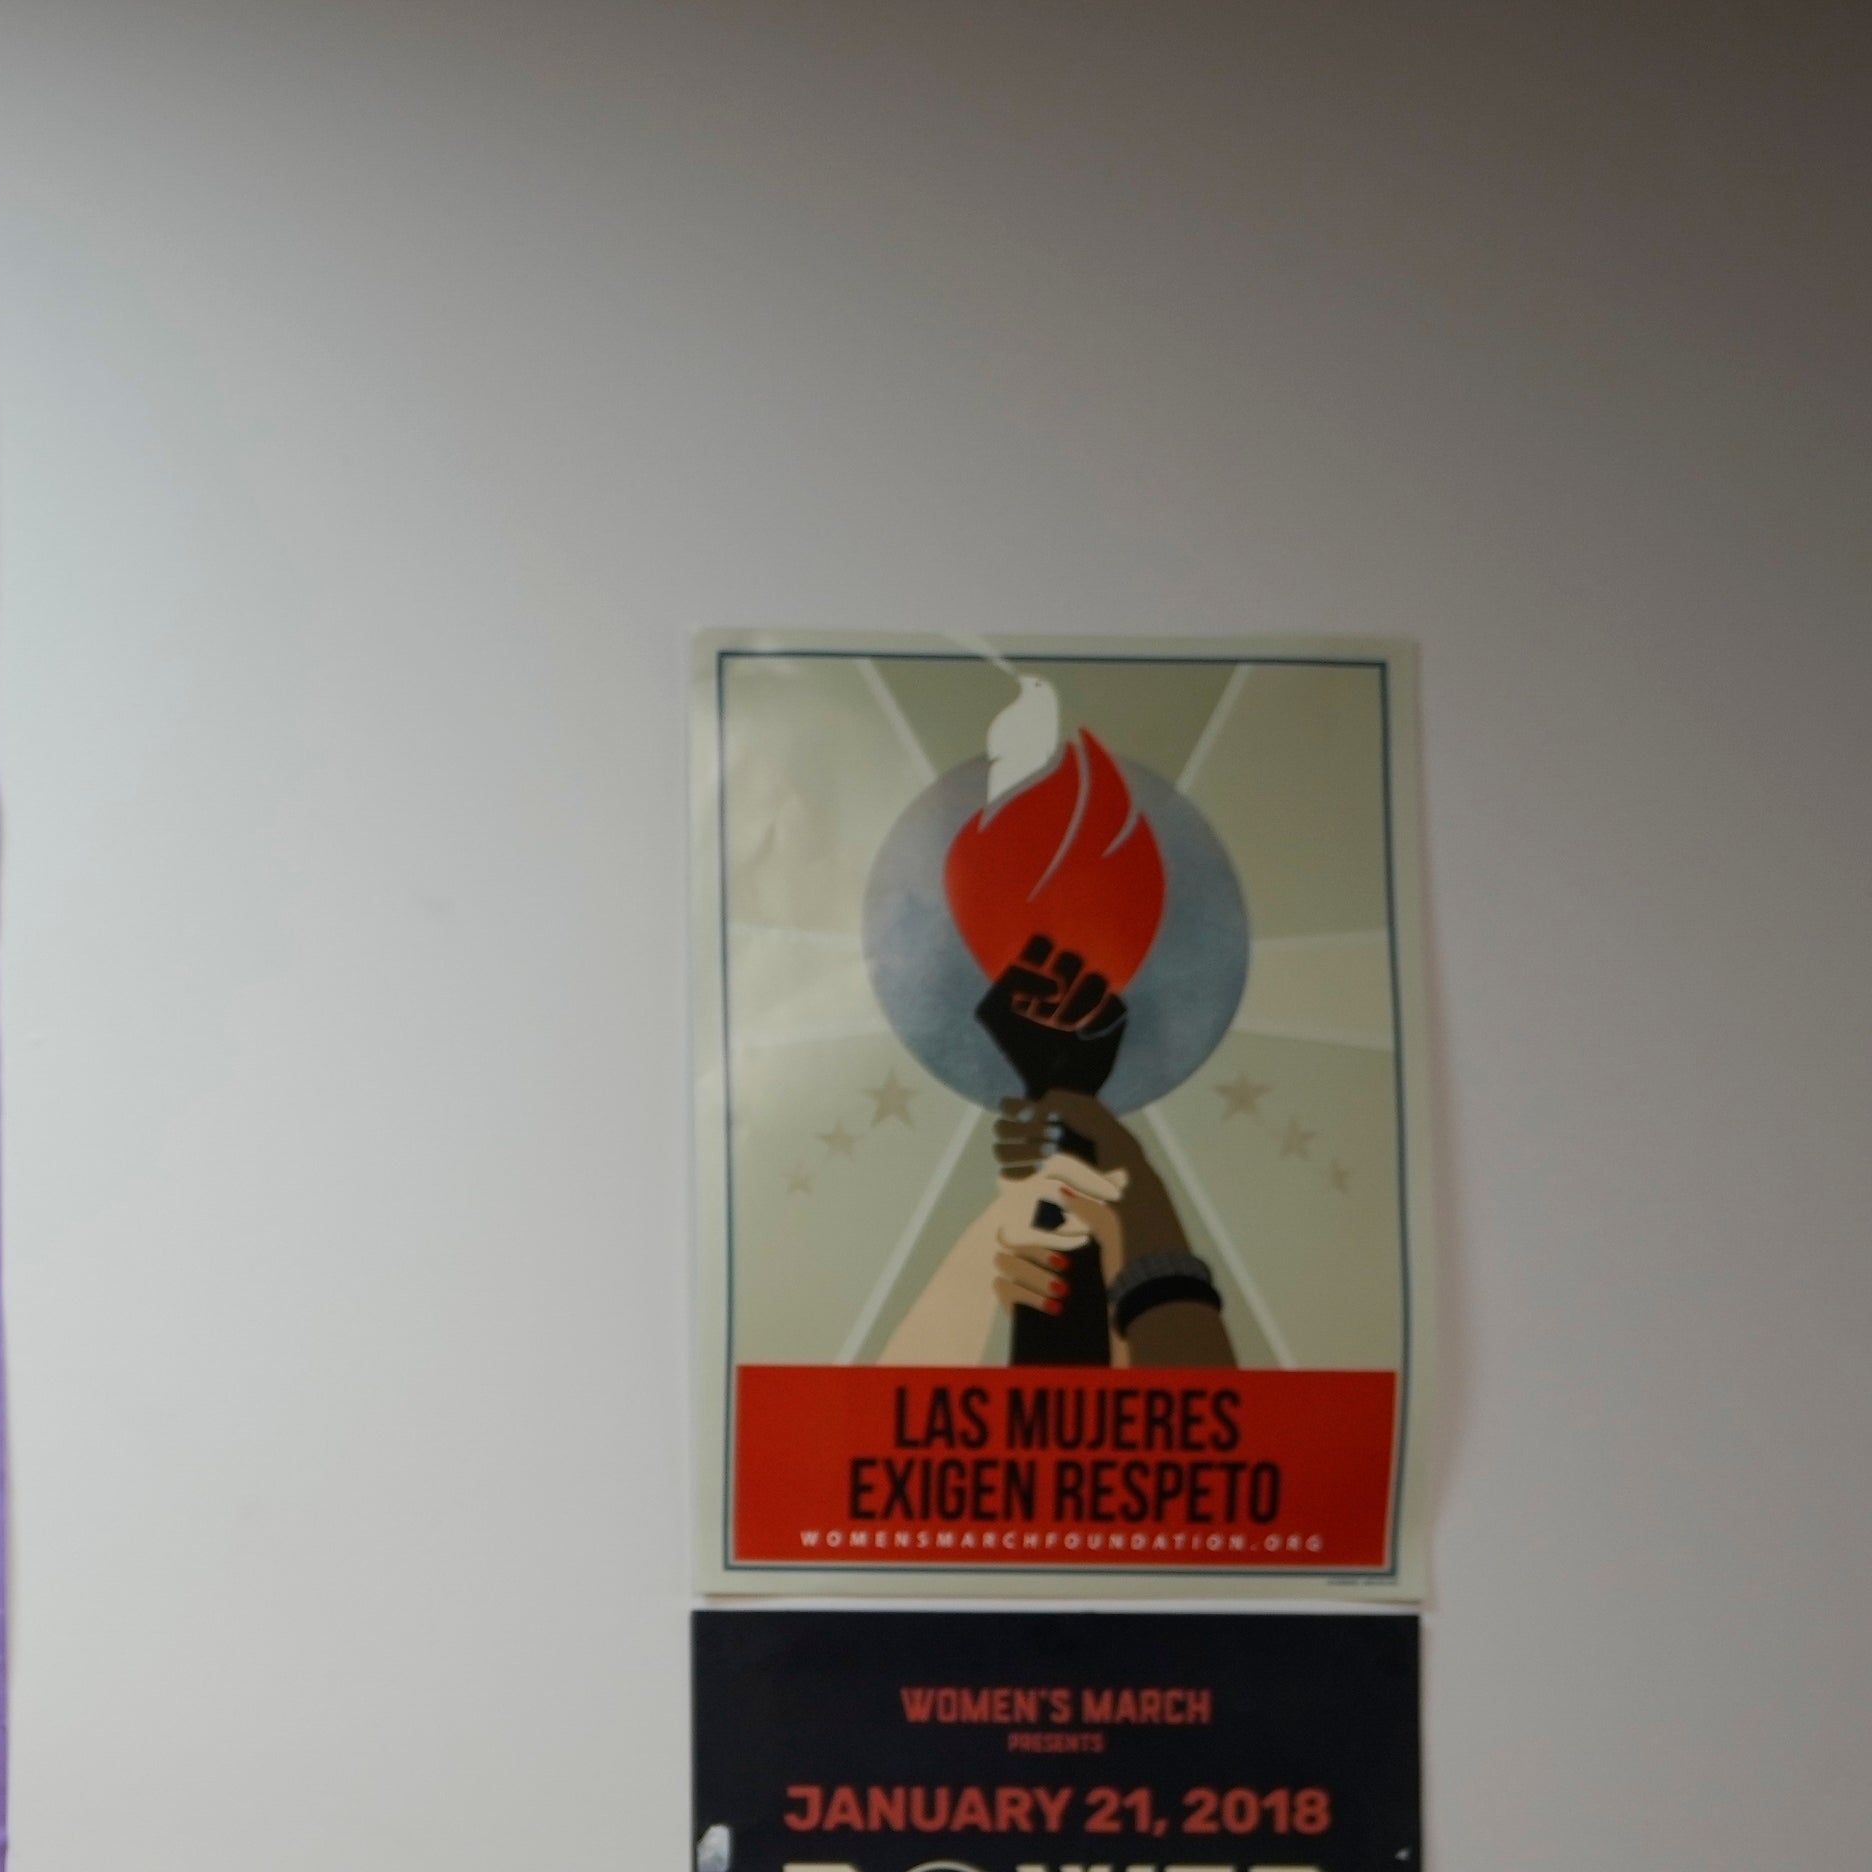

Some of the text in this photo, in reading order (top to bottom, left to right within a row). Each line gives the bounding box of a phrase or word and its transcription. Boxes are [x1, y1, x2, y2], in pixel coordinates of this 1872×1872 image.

[893, 1386, 1242, 1454] LAS MUJERES
[848, 1456, 1282, 1526] EXIGEN RESPETO
[900, 1687, 1213, 1726] WOMEN'S MARCH
[1007, 1731, 1106, 1754] PRESENTS
[784, 1785, 1332, 1836] JANUARY 21, 2018
